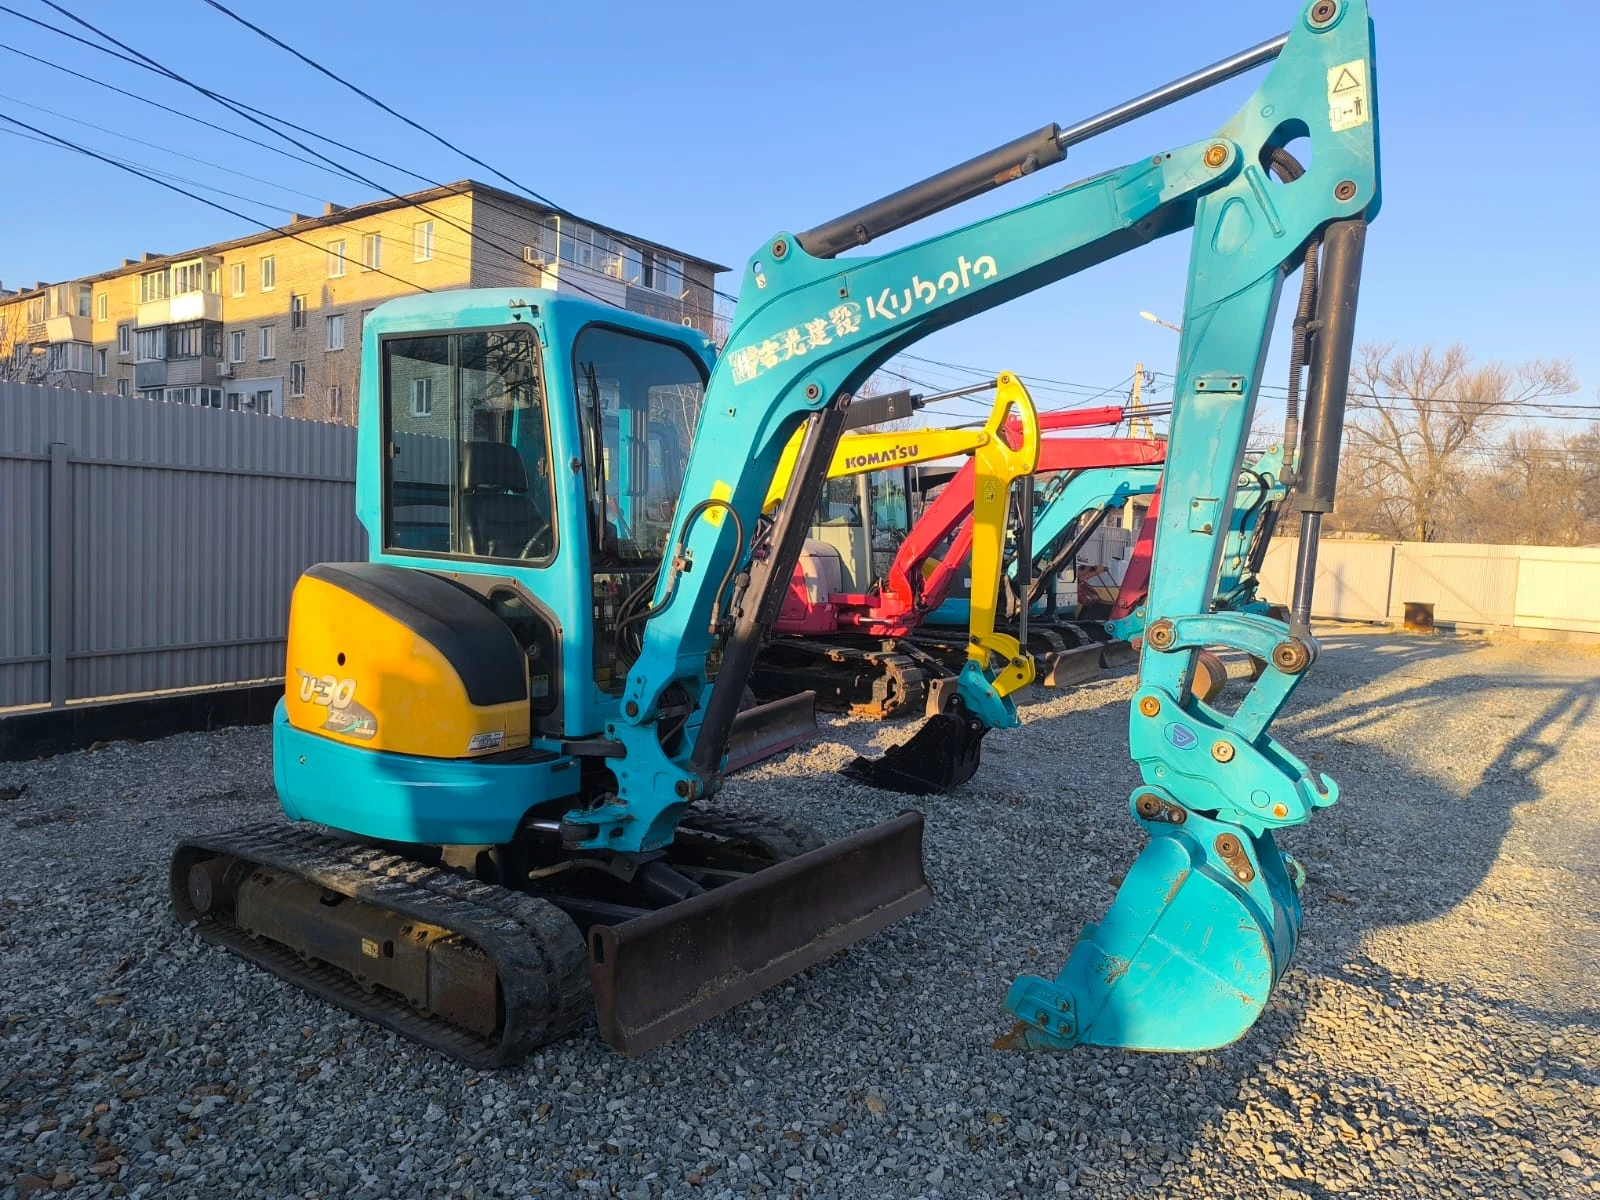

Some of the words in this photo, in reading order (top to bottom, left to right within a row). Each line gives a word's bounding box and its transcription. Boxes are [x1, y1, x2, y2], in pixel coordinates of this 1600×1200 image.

[866, 255, 998, 320] Kubota
[845, 444, 919, 469] KOMATSU
[300, 674, 357, 710] U-30
